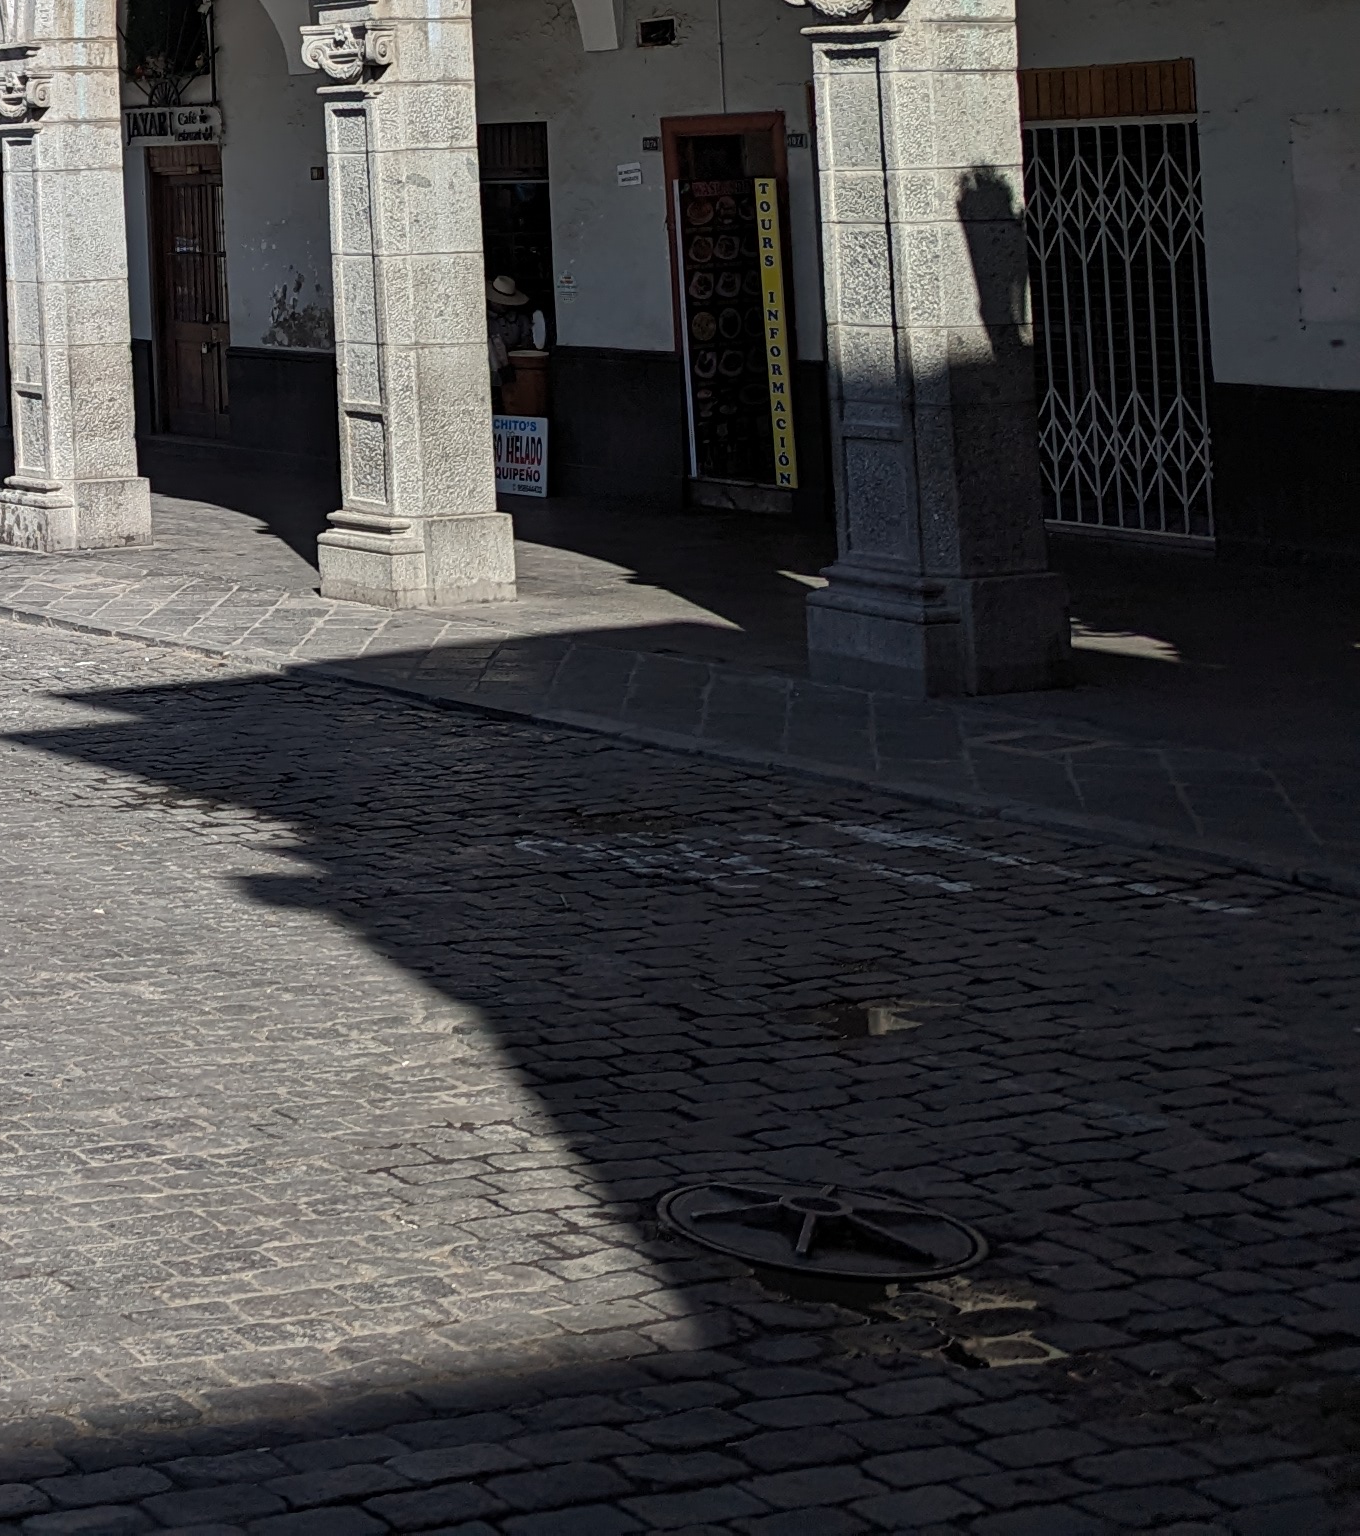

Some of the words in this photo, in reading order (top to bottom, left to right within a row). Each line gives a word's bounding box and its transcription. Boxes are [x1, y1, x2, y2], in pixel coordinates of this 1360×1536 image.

[178, 110, 196, 125] Café
[758, 182, 774, 268] TOURS
[767, 291, 792, 486] INFORMACIÓN
[506, 435, 543, 466] HELADO
[495, 466, 541, 483] QUIPEÑO
